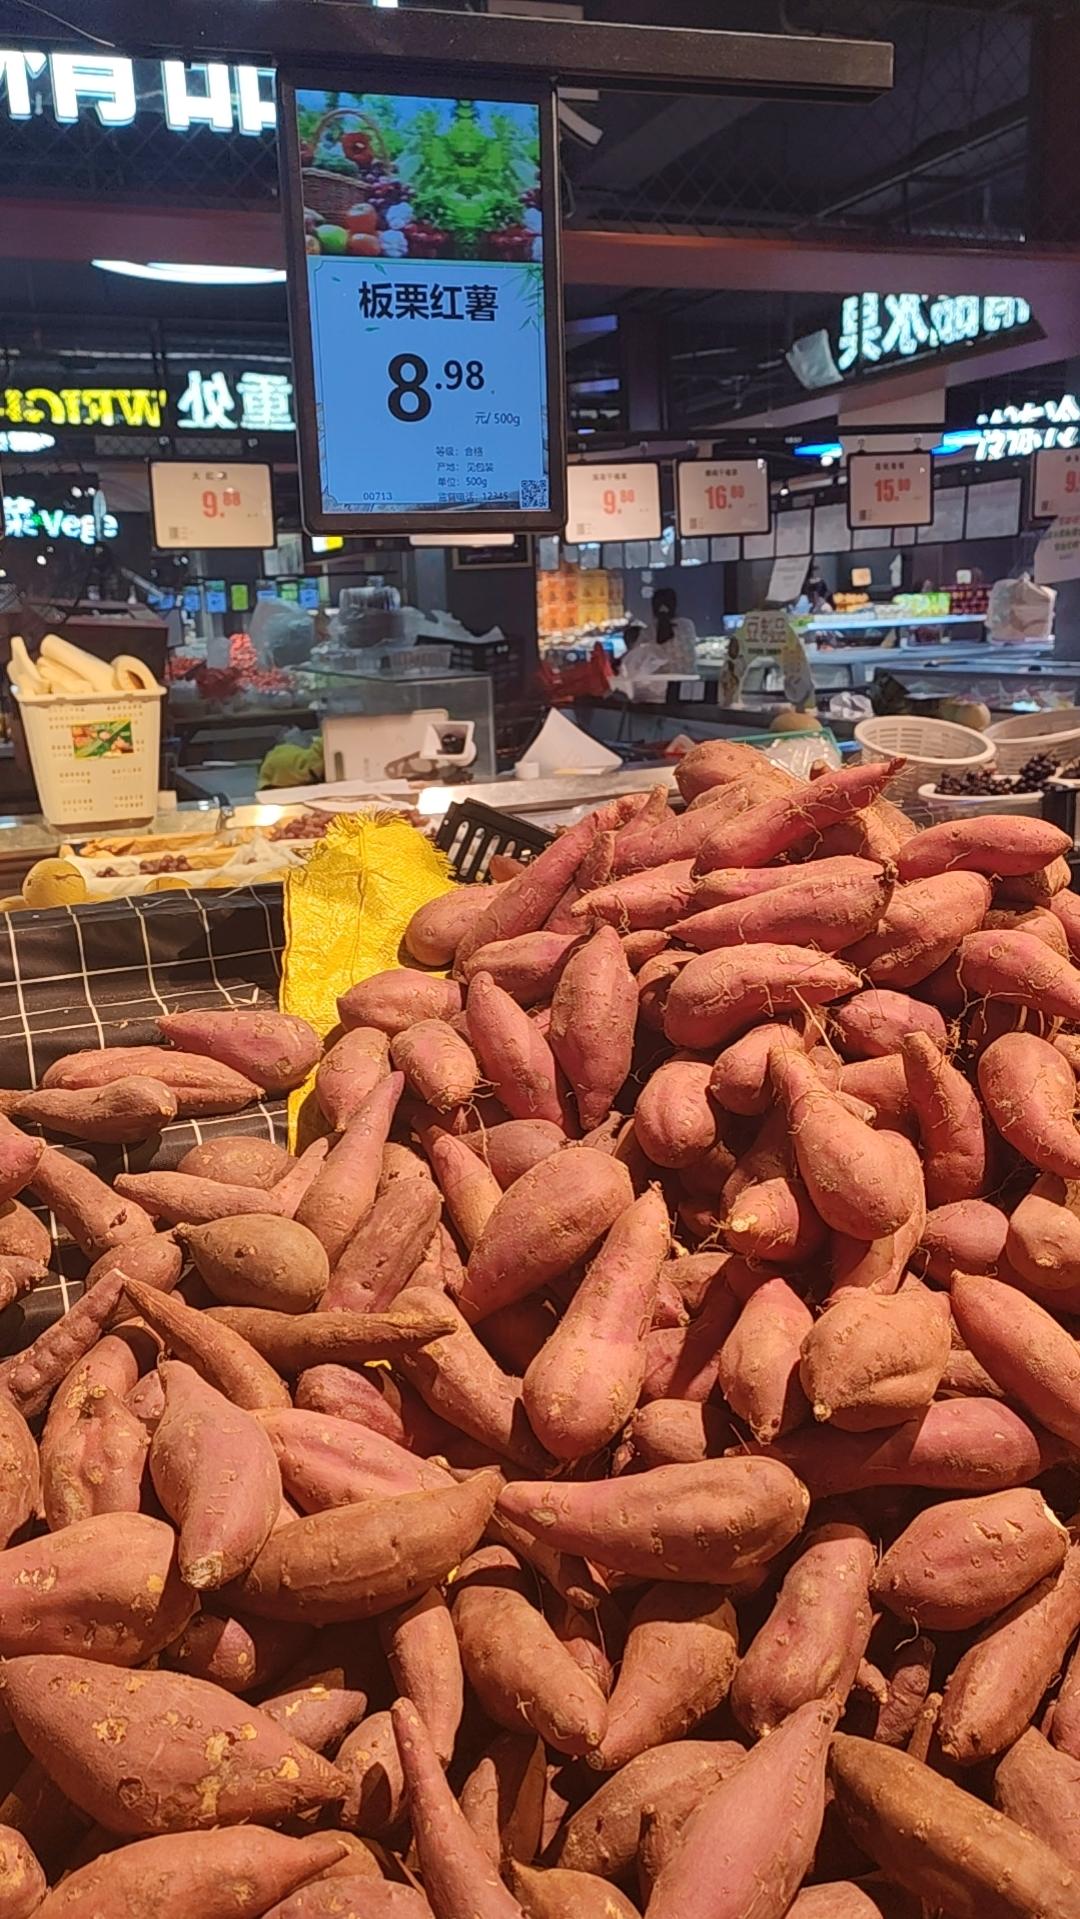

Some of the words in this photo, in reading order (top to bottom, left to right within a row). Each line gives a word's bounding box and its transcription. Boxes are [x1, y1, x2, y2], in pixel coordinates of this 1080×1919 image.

[359, 281, 498, 322] 板栗红薯
[387, 352, 485, 422] 8.98
[363, 491, 392, 501] 00713
